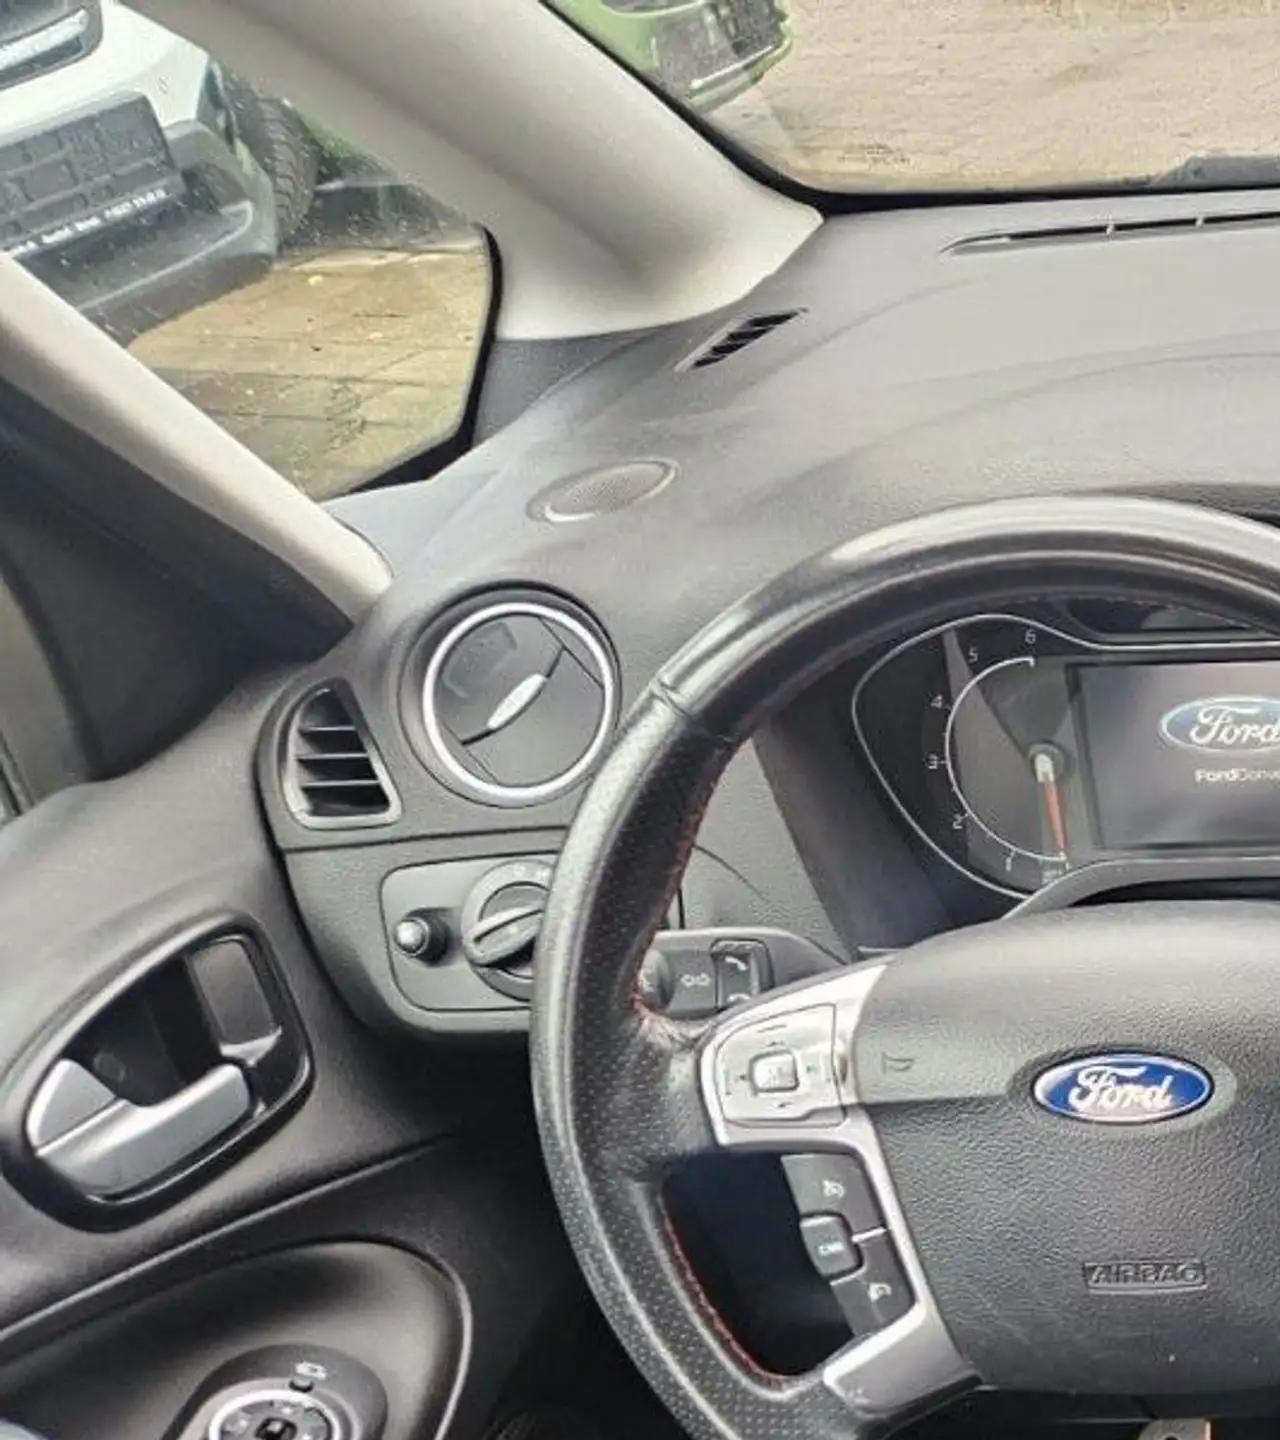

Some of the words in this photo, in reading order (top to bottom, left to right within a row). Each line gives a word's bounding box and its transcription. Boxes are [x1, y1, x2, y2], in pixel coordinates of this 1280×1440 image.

[1025, 629, 1036, 644] 6
[968, 650, 978, 662] 5
[1068, 1065, 1175, 1113] Ford
[1090, 1262, 1204, 1285] AIRBAG
